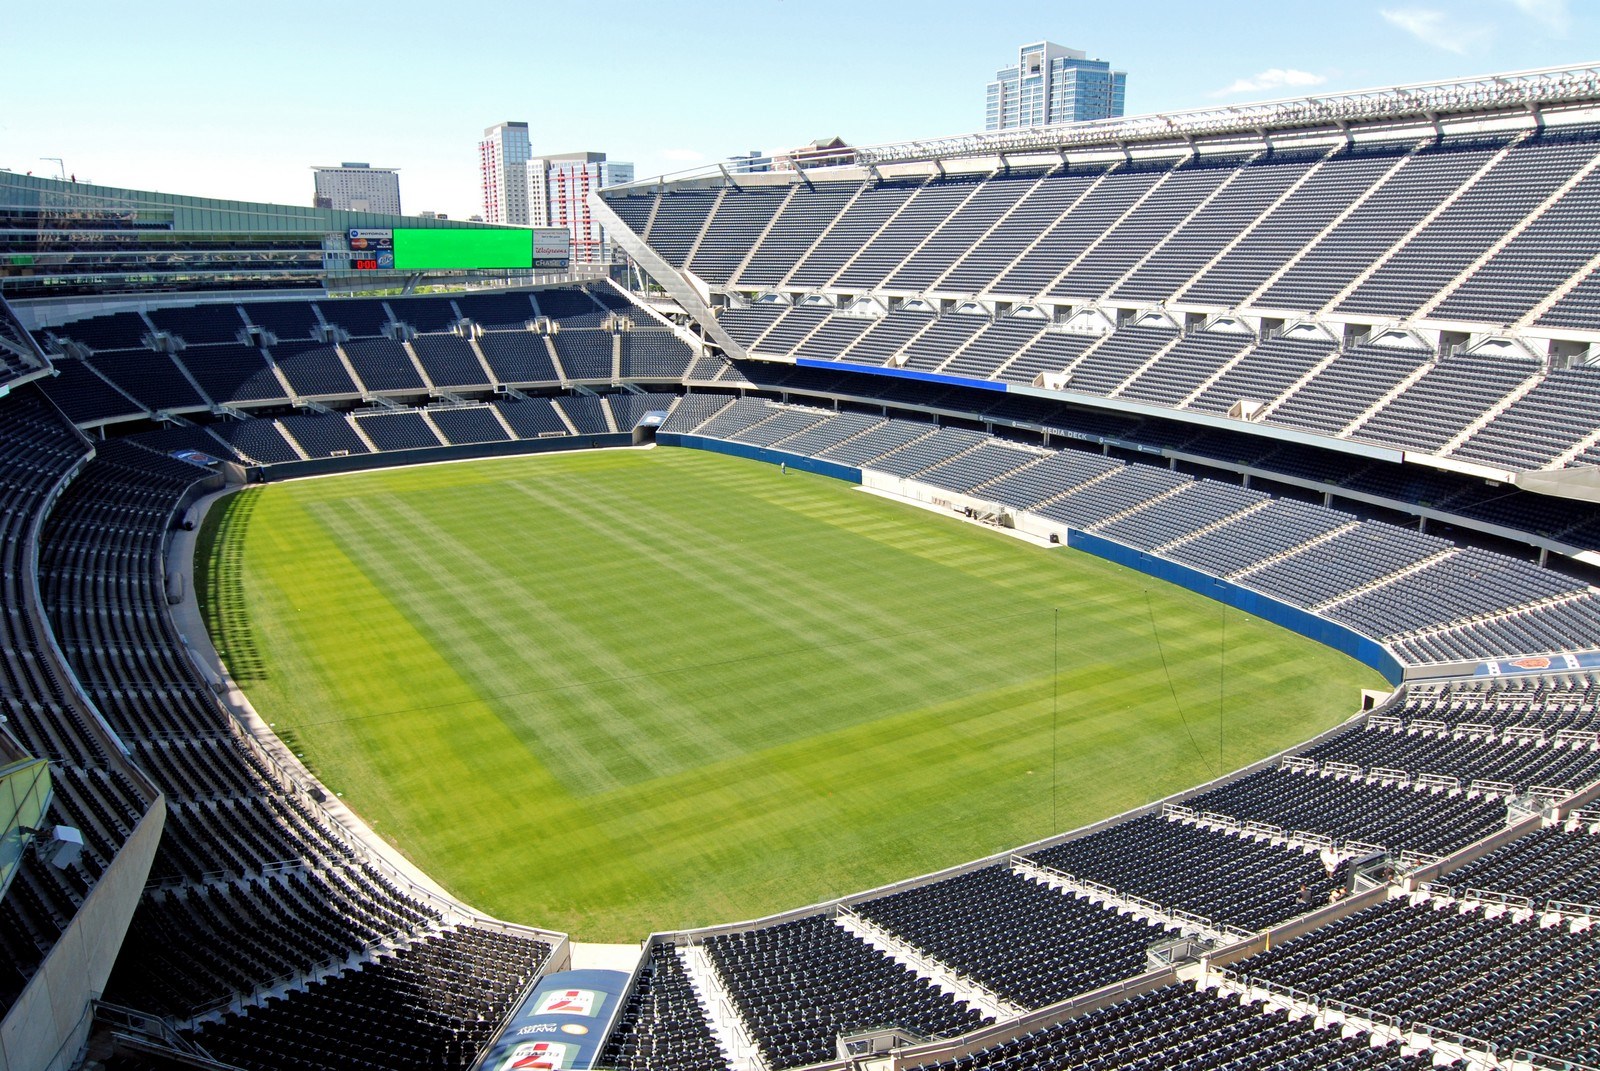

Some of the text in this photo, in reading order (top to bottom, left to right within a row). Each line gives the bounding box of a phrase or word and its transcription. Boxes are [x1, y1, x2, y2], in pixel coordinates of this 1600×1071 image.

[357, 260, 377, 269] 0:00
[1041, 426, 1087, 440] MEDIA DECK
[516, 1026, 557, 1035] PANTRY
